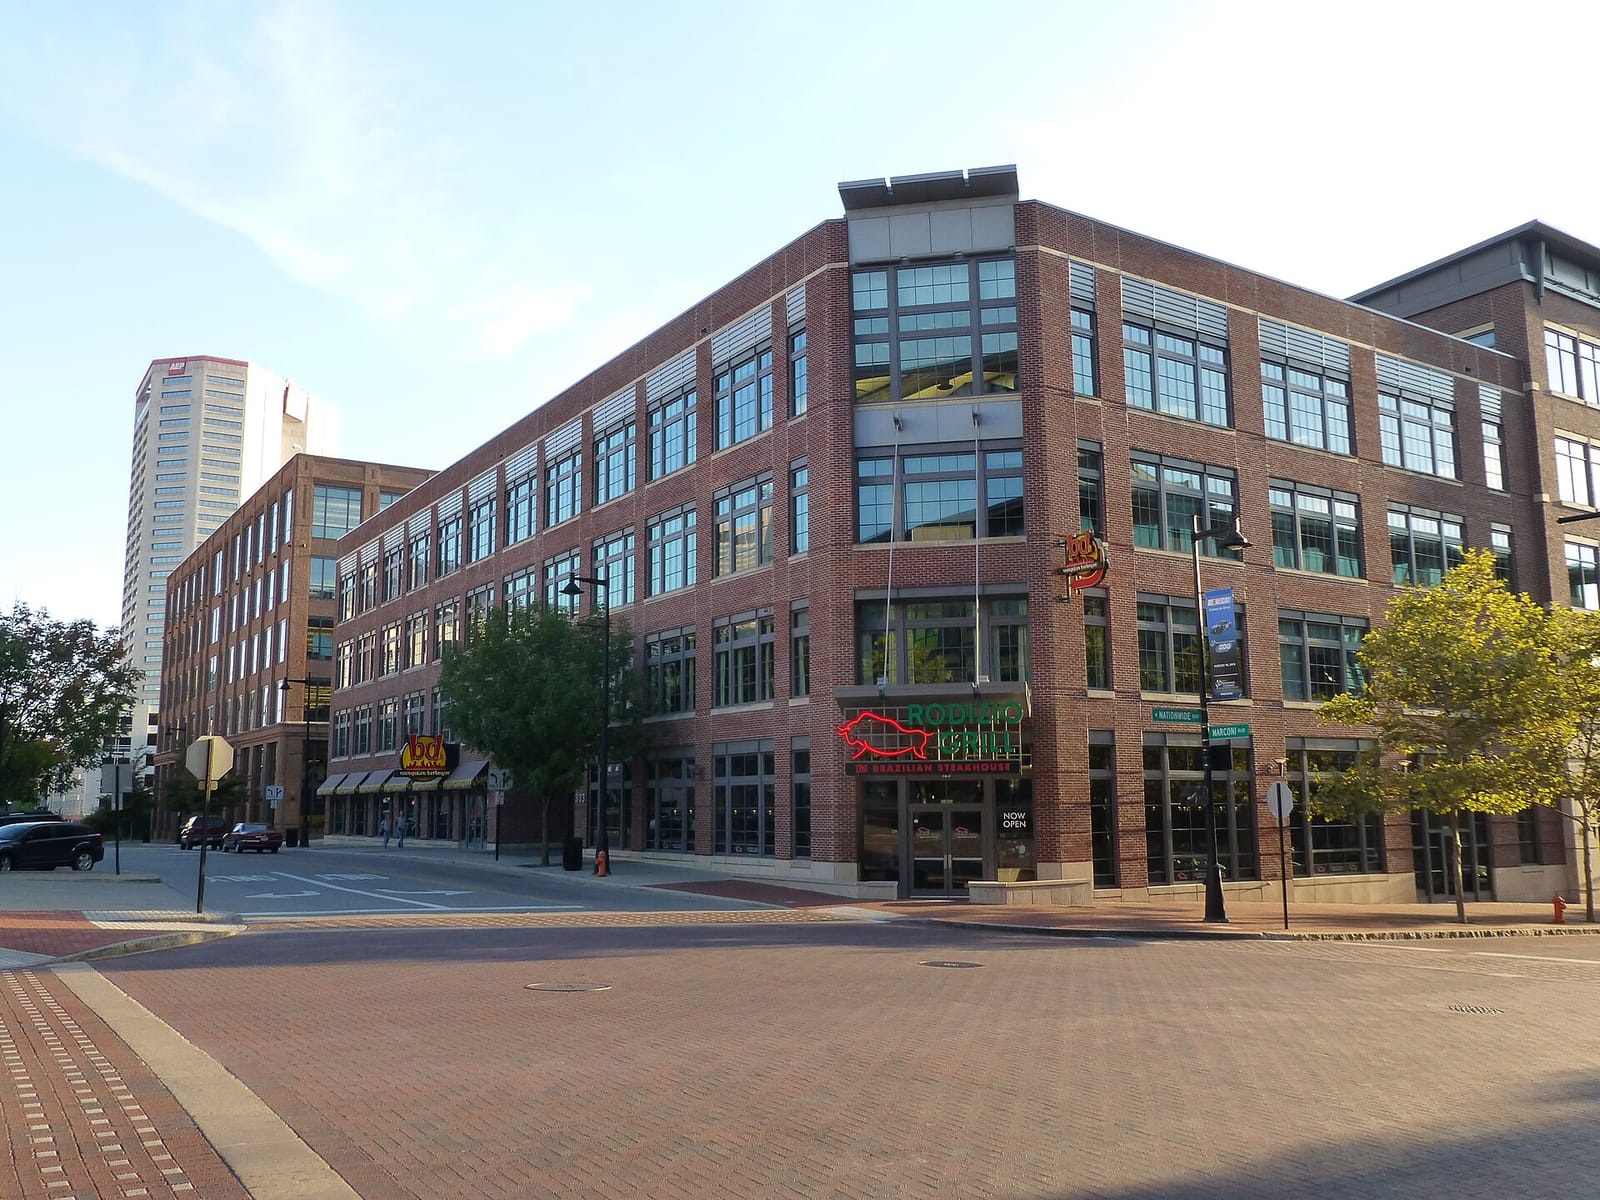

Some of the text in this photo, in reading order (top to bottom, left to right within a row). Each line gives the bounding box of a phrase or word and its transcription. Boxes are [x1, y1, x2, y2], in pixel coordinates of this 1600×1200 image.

[170, 362, 184, 370] AEP
[908, 702, 1023, 725] RODIZIO
[1158, 711, 1191, 720] NATIONWIDE
[1212, 727, 1237, 737] MARCONI
[410, 734, 444, 761] bd
[940, 731, 1016, 754] GRILL
[872, 763, 932, 774] BRAZILIAN
[938, 763, 1010, 773] STEAKHOUSE
[1003, 812, 1026, 820] NOW
[1003, 820, 1026, 828] OPEN
